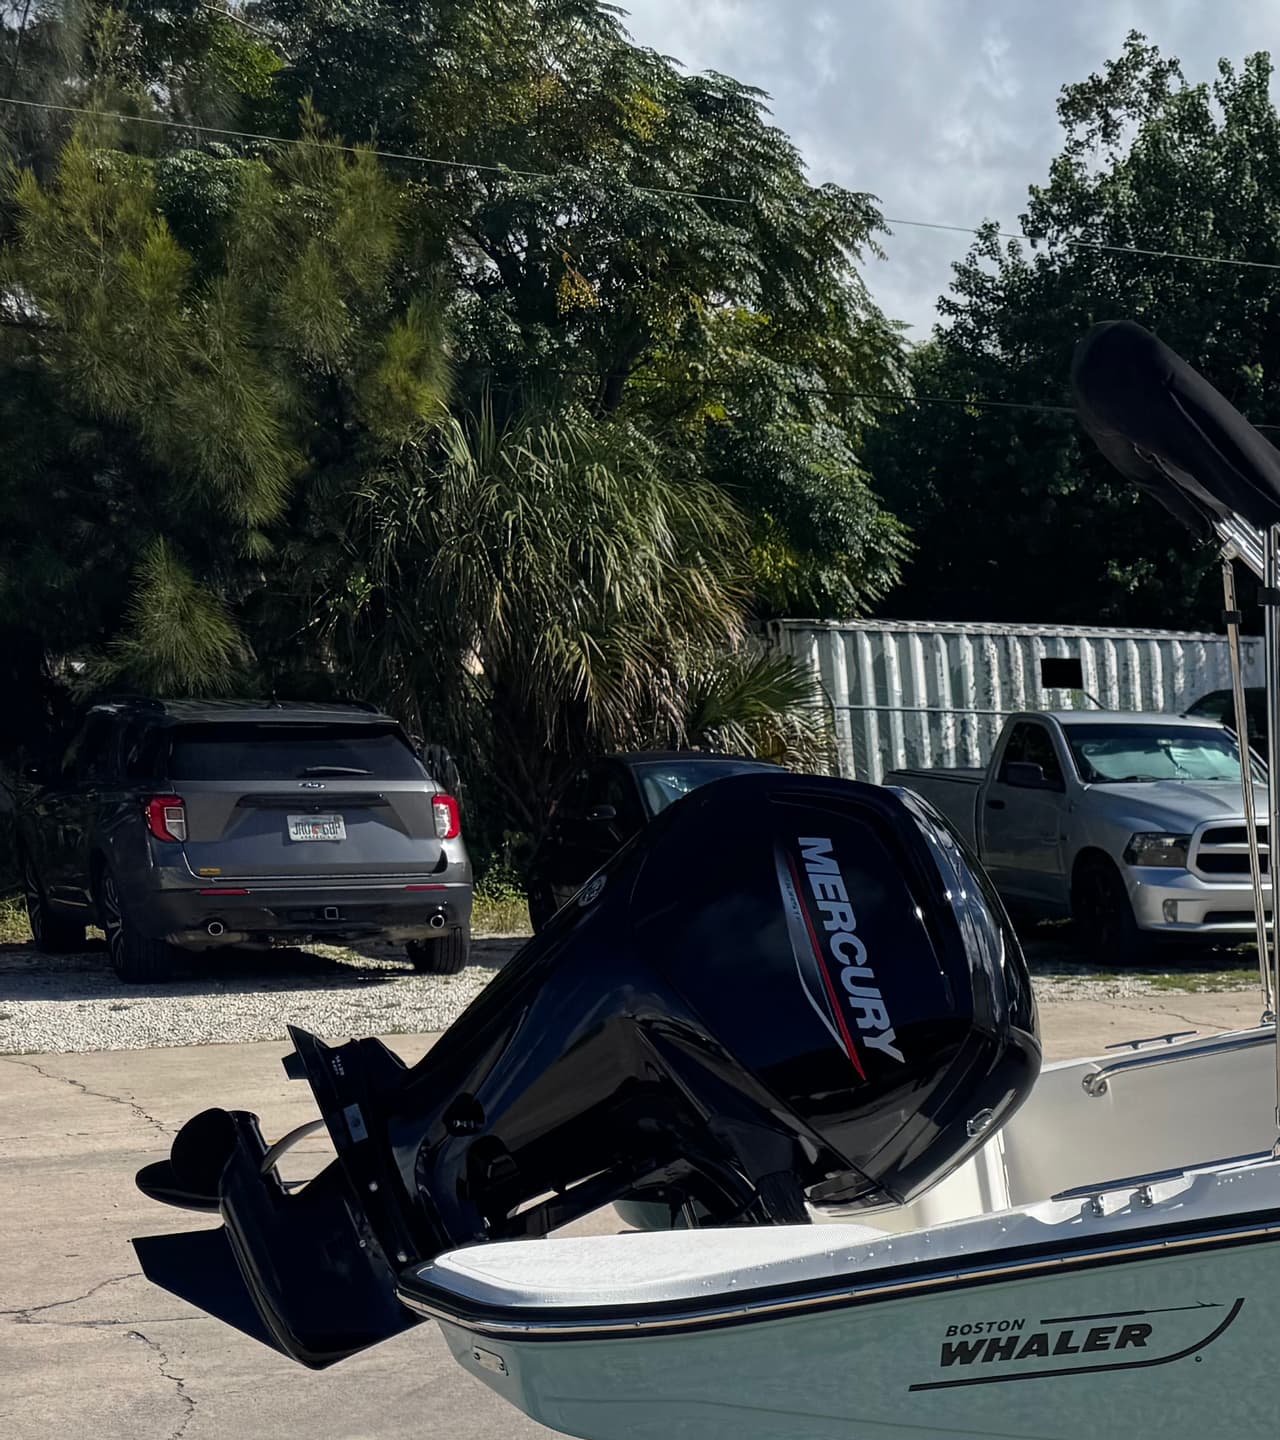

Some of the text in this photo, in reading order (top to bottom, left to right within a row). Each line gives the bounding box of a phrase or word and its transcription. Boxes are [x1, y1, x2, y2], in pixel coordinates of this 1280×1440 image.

[798, 836, 905, 1063] MERCURY
[940, 1323, 1153, 1367] WHALER
[945, 1318, 1025, 1337] BOSTON
